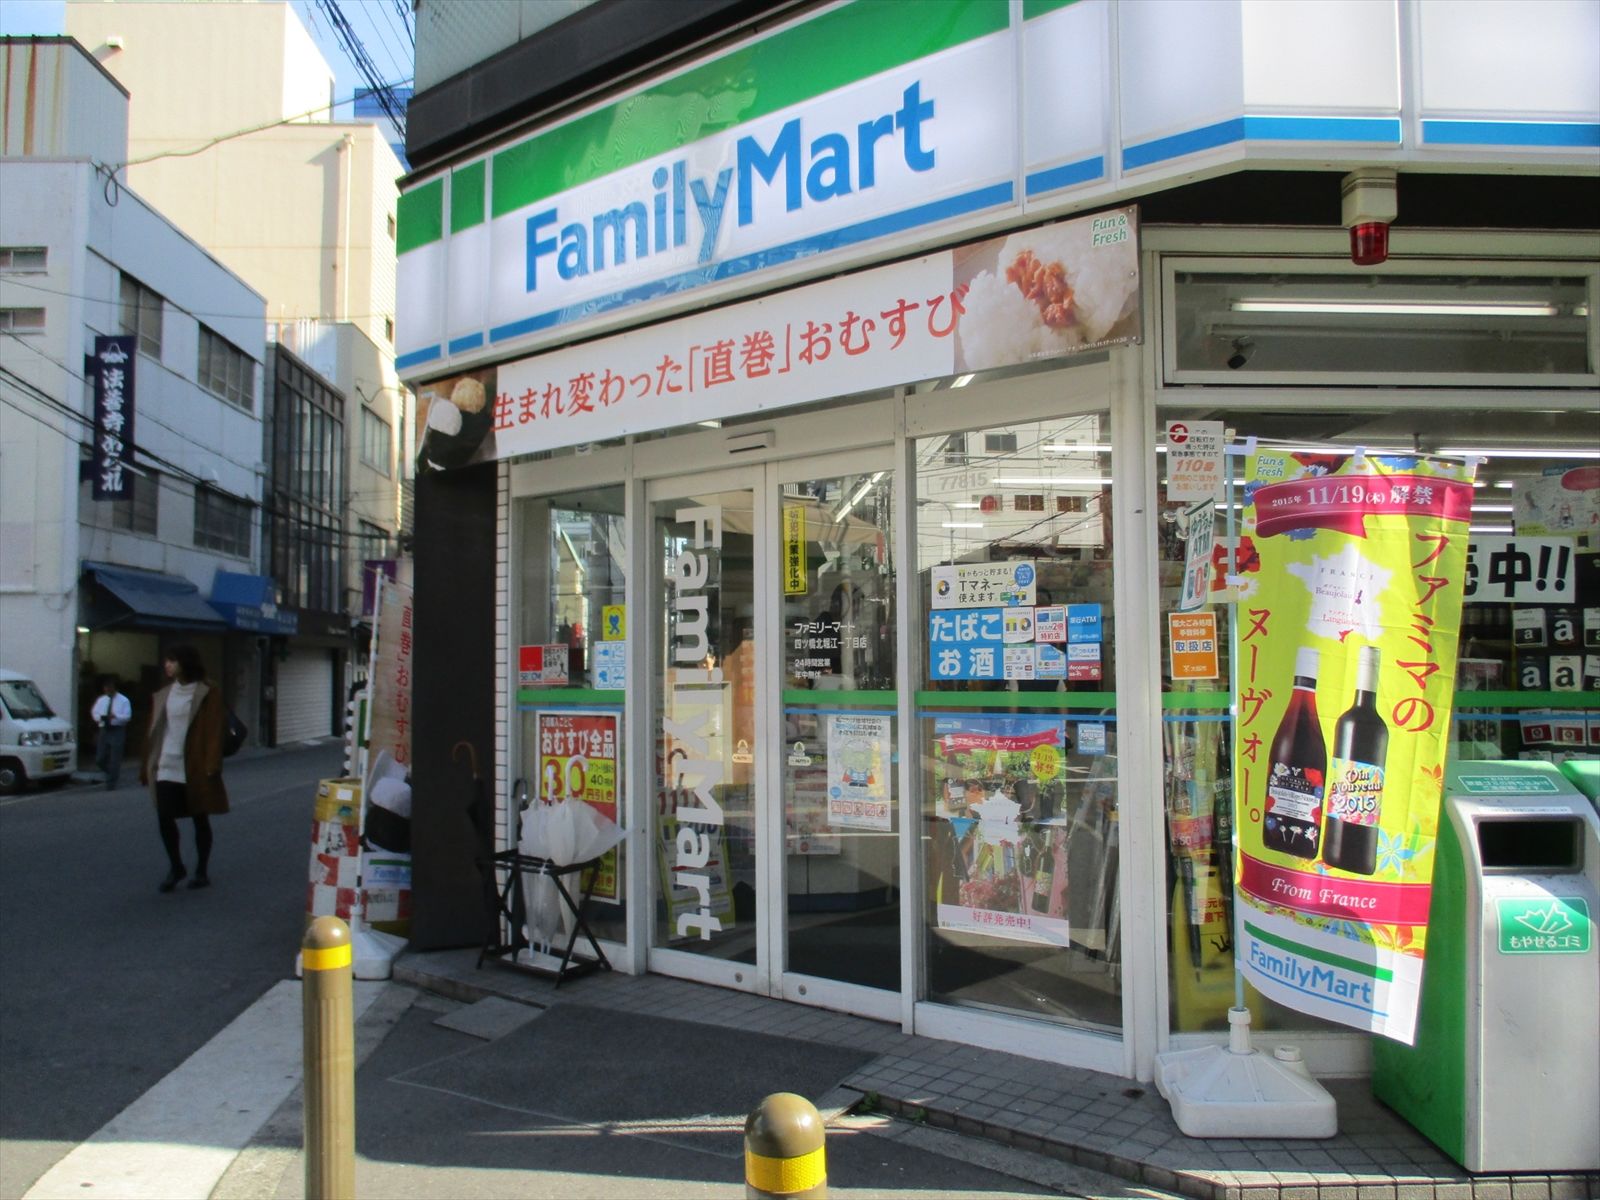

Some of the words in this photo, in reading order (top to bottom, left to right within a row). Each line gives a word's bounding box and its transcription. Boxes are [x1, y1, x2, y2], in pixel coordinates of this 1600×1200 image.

[526, 80, 936, 293] FamilyMart
[1092, 216, 1116, 232] Fun
[1118, 214, 1127, 226] &
[1093, 228, 1127, 246] Fresh
[489, 283, 970, 433] 生まれ変わった「直巻」おむすび
[1176, 459, 1216, 472] 110番
[1257, 455, 1277, 468] Fun
[1257, 466, 1284, 478] Fresh
[939, 472, 988, 490] 77815
[1272, 495, 1302, 508] 2015年
[1390, 485, 1433, 506] 解禁
[959, 579, 1004, 592] Tマネー
[794, 621, 856, 634] ファミリーマート
[931, 612, 1002, 643] たばこ
[1392, 532, 1450, 733] ファミマの
[1175, 639, 1213, 652] 取扱店
[938, 647, 995, 677] お酒
[663, 505, 724, 941] FamilyMart
[1241, 607, 1273, 822] ヌーヴォー。
[541, 729, 615, 759] おむすび全品
[544, 759, 586, 799] 30
[1335, 794, 1377, 814] 2015
[1271, 877, 1312, 901] From
[1318, 890, 1377, 909] France
[972, 911, 1031, 929] 好評発売中!
[1509, 935, 1582, 949] もやせるゴミ
[1250, 940, 1372, 1004] FamilyMart
